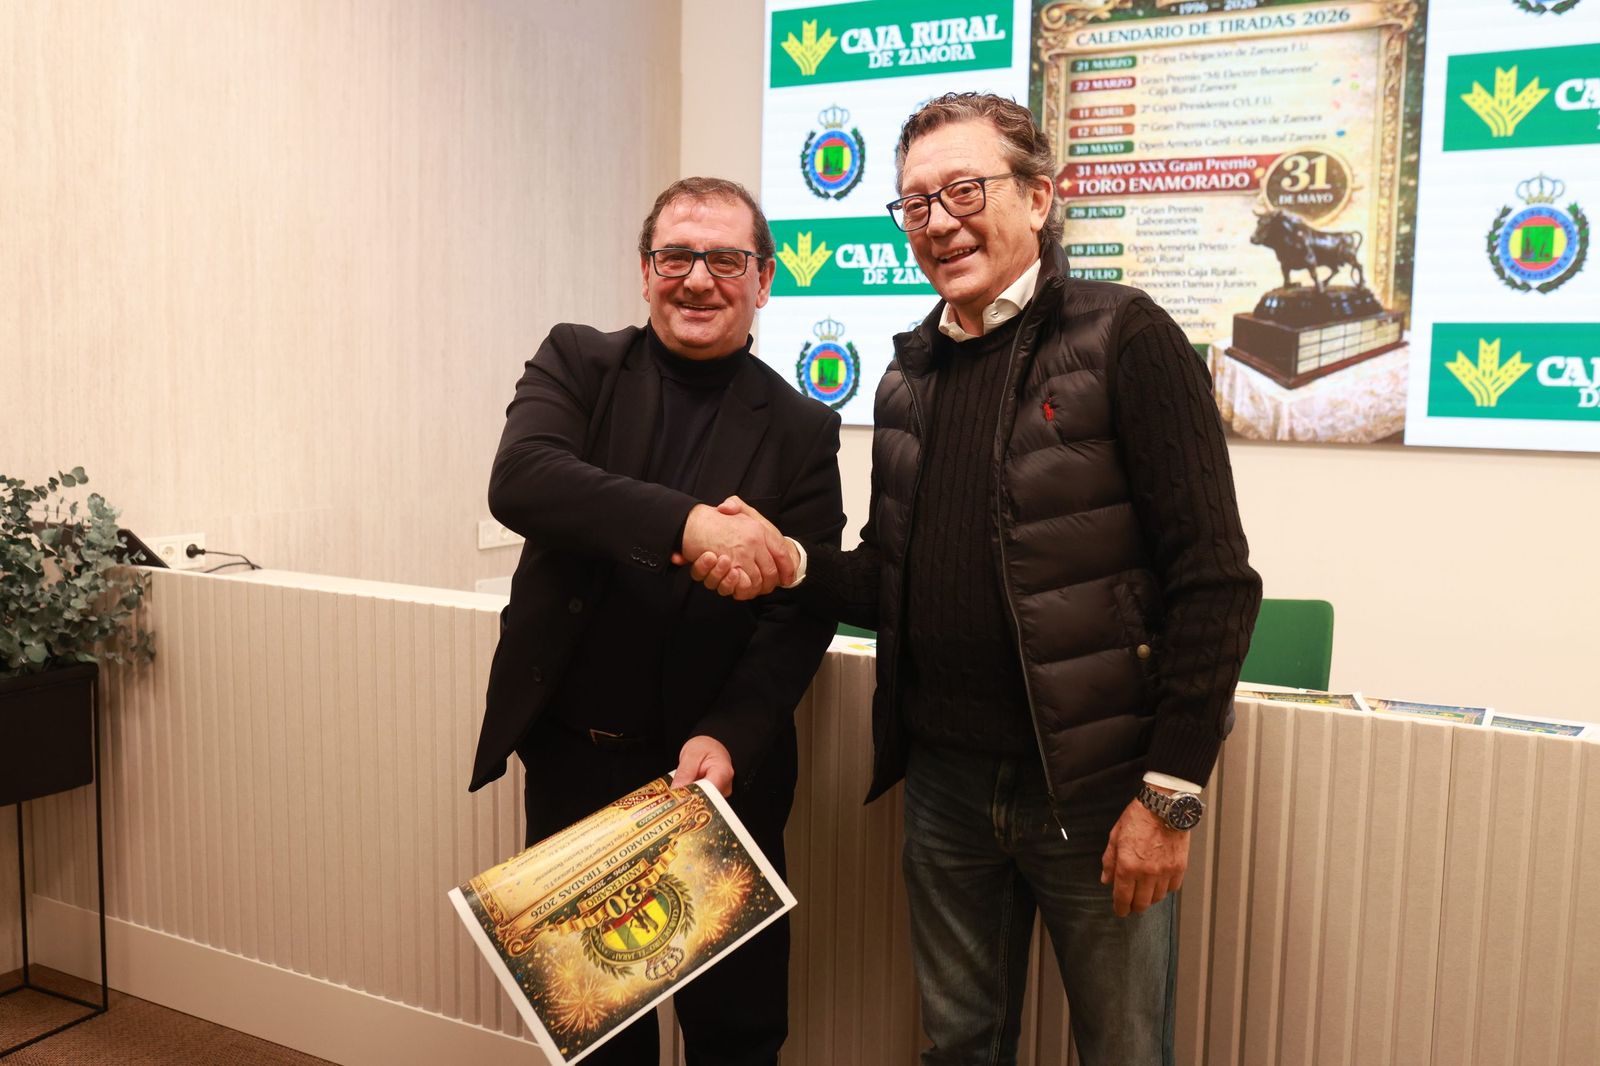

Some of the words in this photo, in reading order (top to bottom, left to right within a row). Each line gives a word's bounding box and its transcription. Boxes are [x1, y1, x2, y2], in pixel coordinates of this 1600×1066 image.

[840, 24, 906, 54] CAJA
[910, 14, 1006, 48] RURAL
[1076, 24, 1184, 46] CALENDARIO
[1189, 20, 1211, 36] DE
[1219, 12, 1296, 33] TIRADAS
[1303, 8, 1350, 26] 2026
[868, 50, 894, 69] DE
[898, 43, 976, 66] ZAMORA
[1092, 58, 1132, 70] MARZO
[1076, 81, 1090, 91] 22
[1092, 78, 1132, 89] MARZO
[1554, 78, 1600, 110] CA
[1090, 143, 1124, 153] MAYO
[1076, 164, 1091, 177] 31
[1094, 163, 1136, 175] MAYO
[1139, 161, 1165, 173] XXX
[1168, 160, 1203, 172] Gran
[1205, 157, 1257, 171] Premio
[1281, 154, 1332, 192] 31
[1076, 178, 1126, 194] TORO
[1129, 172, 1250, 192] ENAMORADO
[1279, 194, 1294, 204] DE
[1297, 193, 1334, 204] MAYO
[1088, 207, 1122, 218] JUNIO
[835, 243, 900, 268] CAJA
[1086, 244, 1119, 256] JULIO
[862, 268, 888, 285] DE
[892, 268, 931, 284] ZAM
[1085, 268, 1118, 280] JULIO
[1536, 356, 1600, 387] CAJ
[1577, 387, 1600, 408] D
[638, 807, 663, 827] MARZO
[618, 811, 682, 859] CALENDARIO
[603, 855, 619, 869] DE
[612, 862, 631, 878] 1996
[558, 865, 603, 901] TIRADAS
[585, 865, 643, 909] ANIVERSARIO
[586, 879, 607, 896] 2026
[530, 897, 558, 920] 2026
[601, 881, 646, 922] 30
